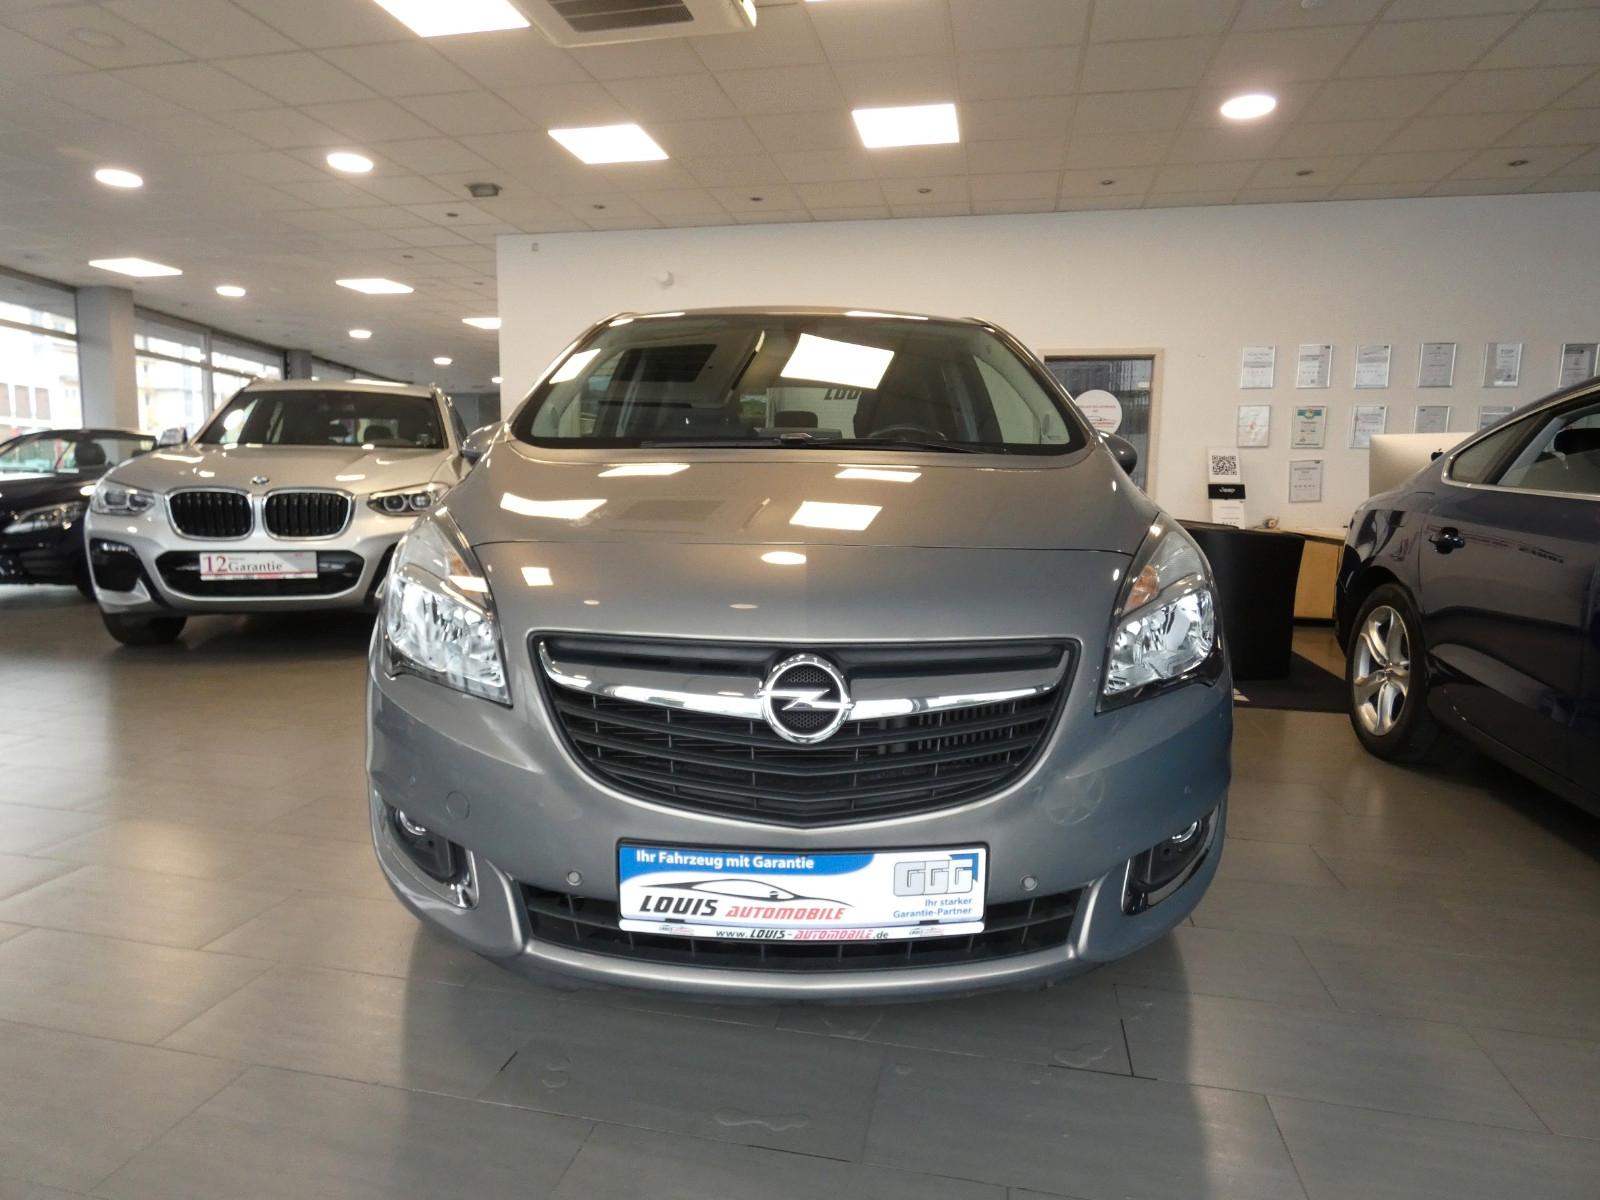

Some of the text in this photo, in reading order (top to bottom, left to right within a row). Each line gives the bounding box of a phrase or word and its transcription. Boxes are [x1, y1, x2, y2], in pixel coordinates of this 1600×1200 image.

[202, 555, 282, 572] 12 Garantie
[636, 850, 814, 869] Ihr Fahrzeug mit Garantie
[639, 895, 718, 917] LOUIS
[925, 897, 972, 907] Ihr starker
[893, 907, 972, 919] Garantie-Partner
